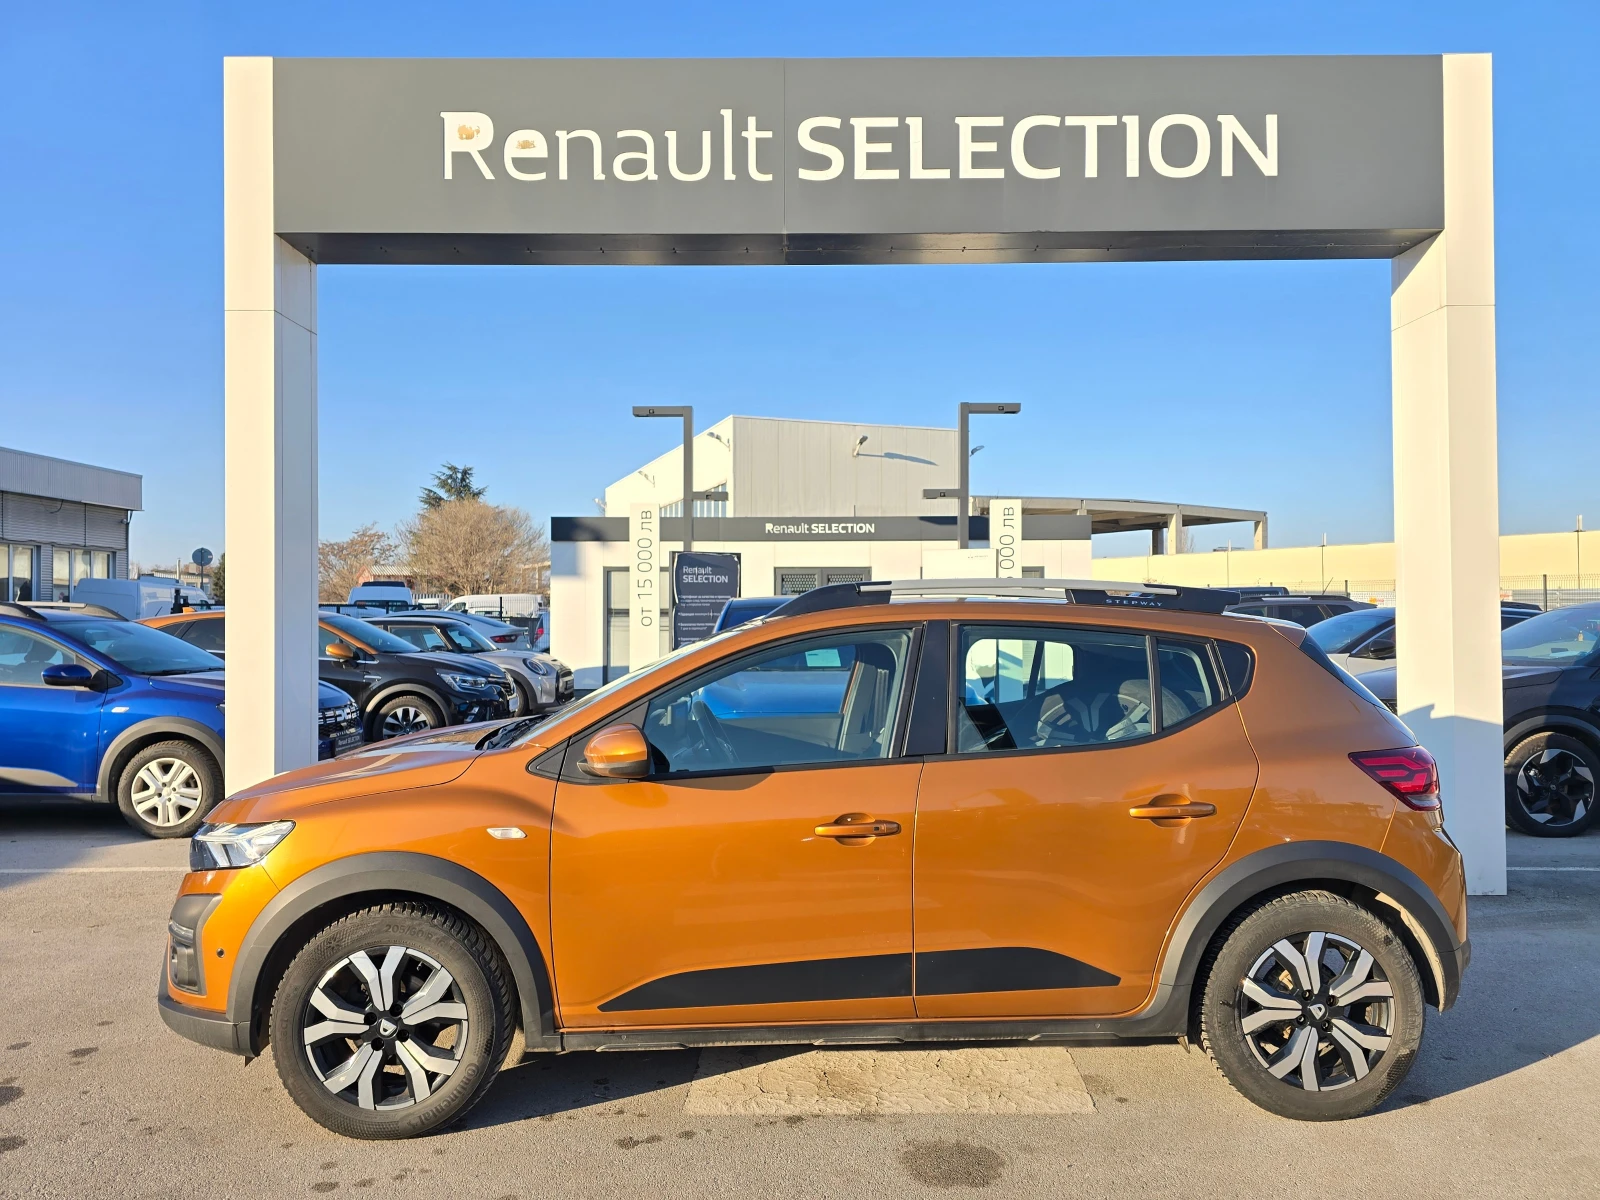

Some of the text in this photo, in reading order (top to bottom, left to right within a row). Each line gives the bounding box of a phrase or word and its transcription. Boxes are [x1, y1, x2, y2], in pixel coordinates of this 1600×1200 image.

[440, 108, 1279, 181] Renault SELECTION
[765, 522, 875, 534] Renault SELECTION
[637, 537, 653, 573] 000
[999, 534, 1015, 570] 000
[682, 565, 712, 575] Renault
[682, 575, 729, 584] SELECTION
[637, 578, 653, 600] 15
[1105, 598, 1163, 607] STEPWAY
[123, 753, 148, 781] UNIROYAL
[384, 923, 425, 937] 205/60
[418, 1062, 479, 1126] Continental
